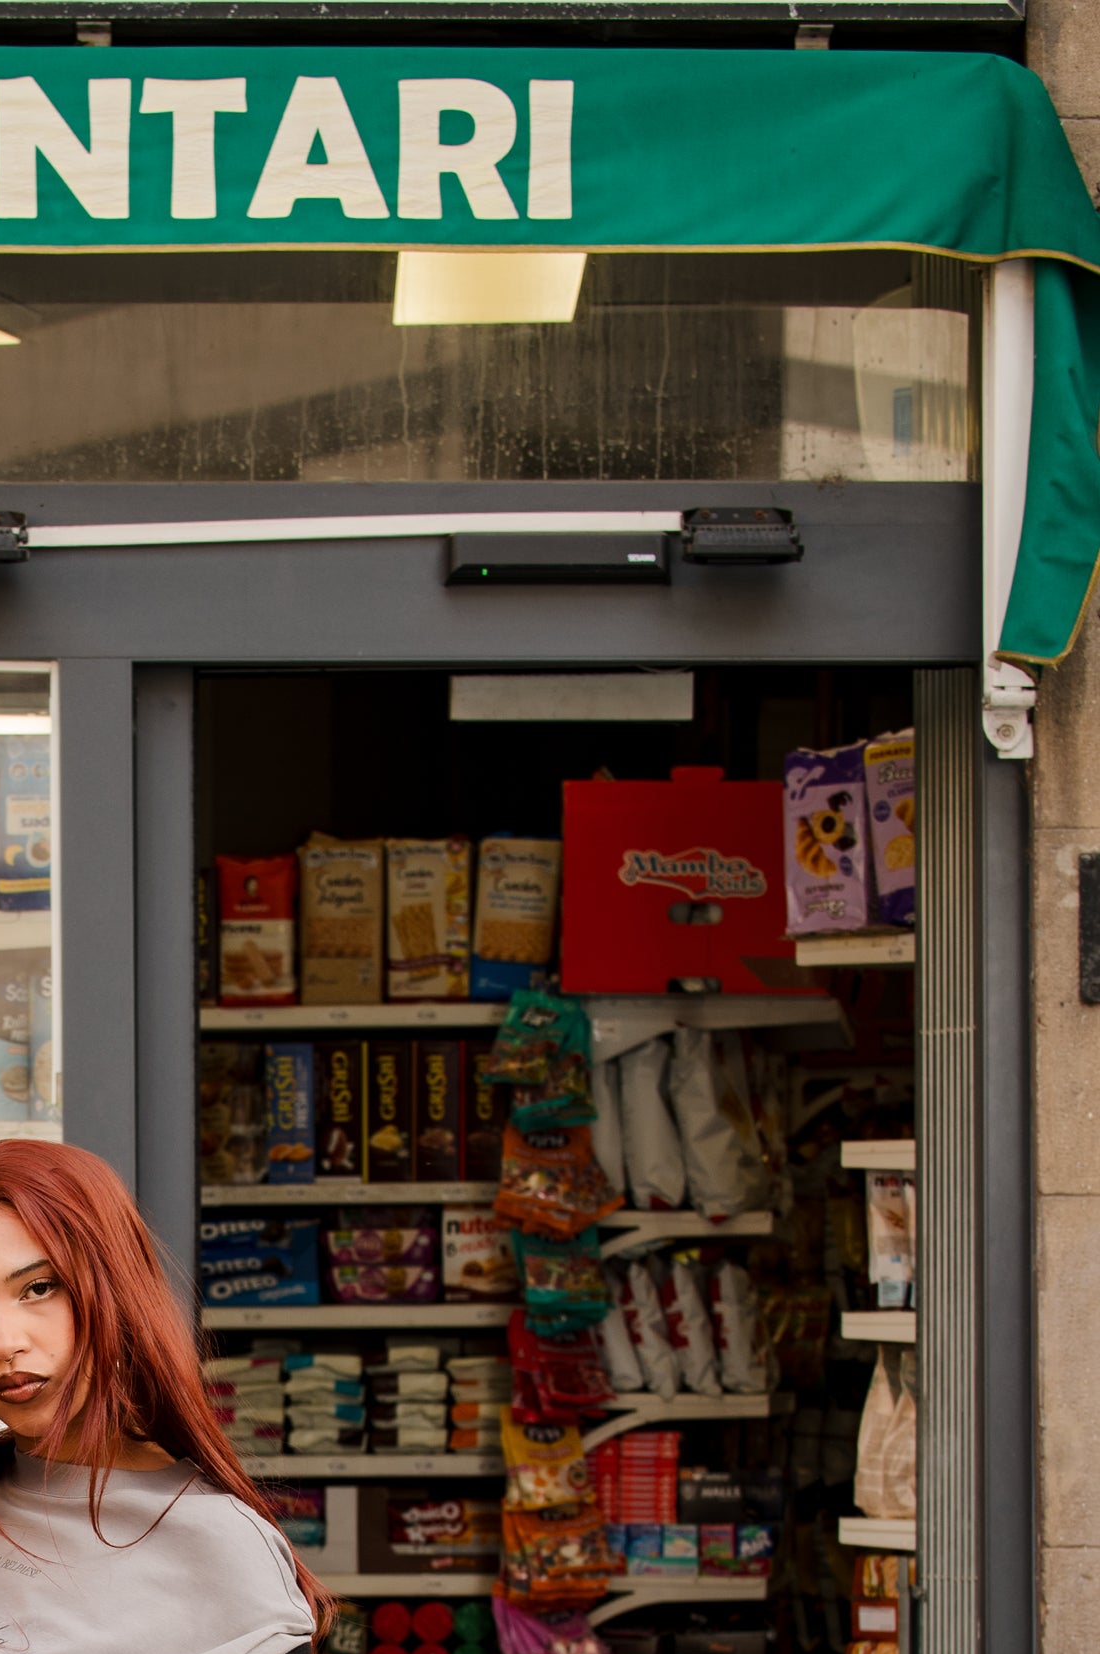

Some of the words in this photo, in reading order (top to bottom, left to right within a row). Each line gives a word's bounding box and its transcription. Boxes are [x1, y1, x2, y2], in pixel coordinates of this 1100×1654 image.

[624, 848, 748, 876] Mambo
[707, 874, 764, 892] Kids
[200, 1219, 266, 1240] OREO
[209, 1275, 279, 1300] OREO
